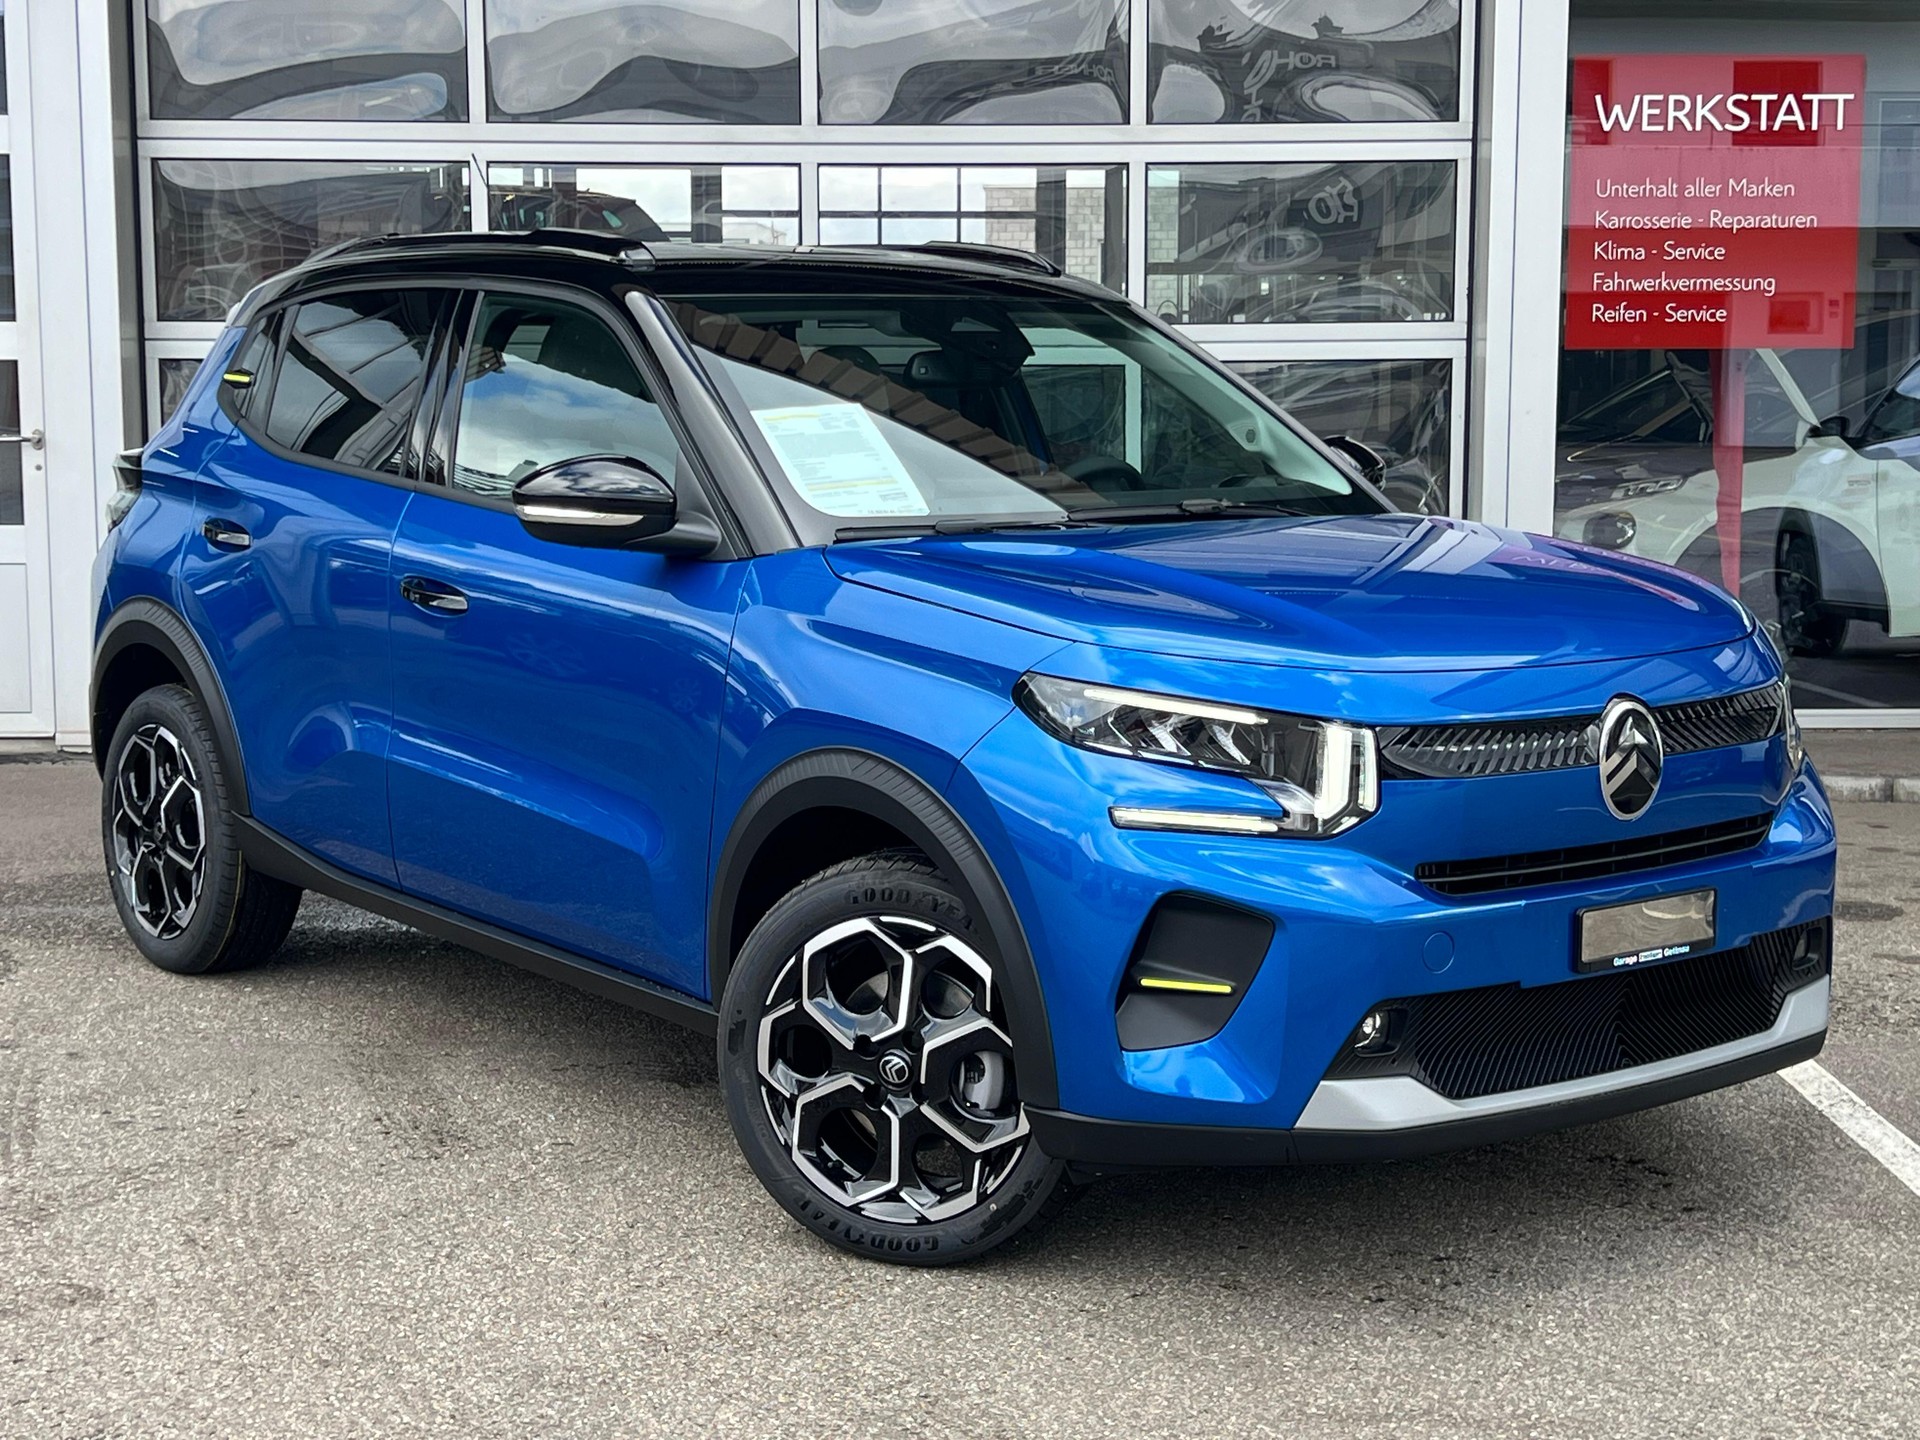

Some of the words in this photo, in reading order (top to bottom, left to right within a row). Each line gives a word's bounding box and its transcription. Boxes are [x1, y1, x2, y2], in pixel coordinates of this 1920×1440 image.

[1594, 93, 1855, 132] WERKSTATT
[1596, 177, 1679, 198] Unterhalt
[1684, 177, 1722, 198] aller
[1728, 177, 1796, 197] Marken
[1595, 209, 1693, 230] Karrosserie
[1709, 209, 1818, 234] Reparaturen
[1594, 240, 1646, 261] Klima
[1662, 240, 1726, 261] Service
[1592, 271, 1776, 297] Fahrwerkvermessung
[1591, 302, 1647, 323] Reifen
[1664, 302, 1728, 323] Service
[1613, 955, 1637, 966] Garage
